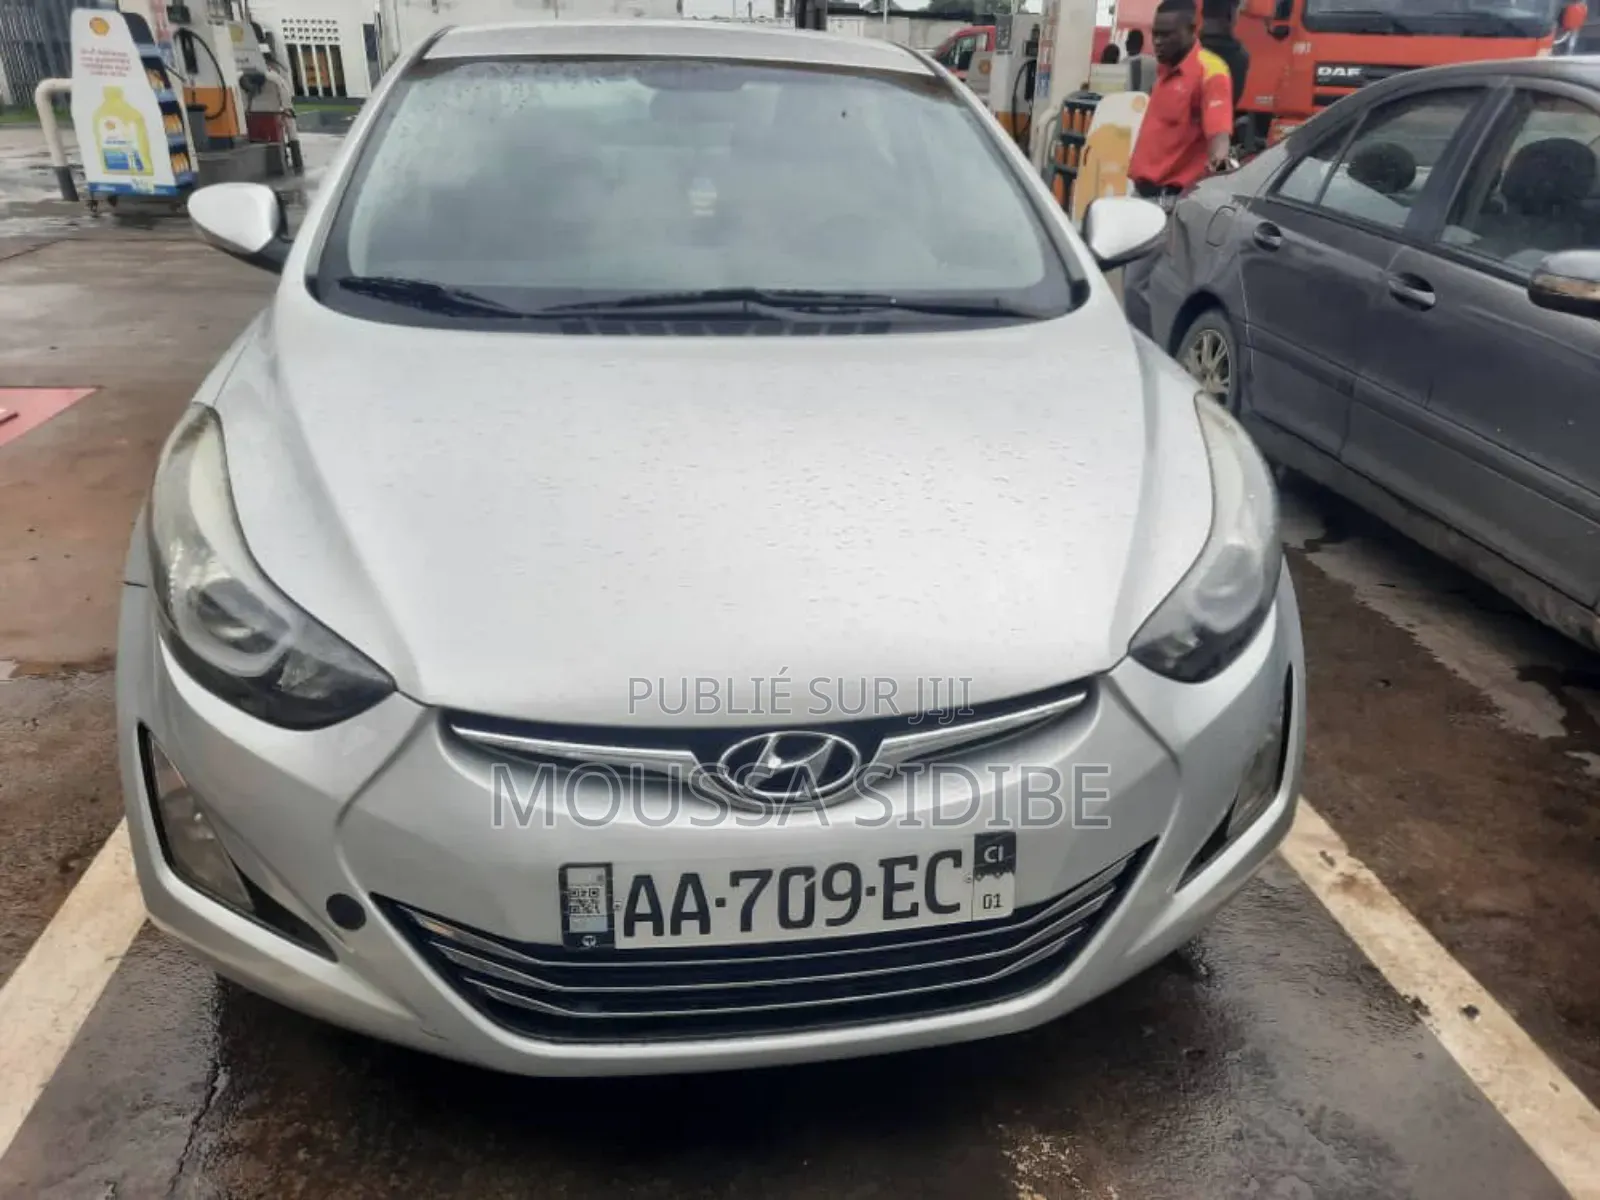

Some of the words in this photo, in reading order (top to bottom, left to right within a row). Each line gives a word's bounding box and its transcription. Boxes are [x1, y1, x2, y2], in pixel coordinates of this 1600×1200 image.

[1317, 66, 1362, 76] DAF
[984, 845, 1005, 864] CI
[983, 893, 1003, 911] 01
